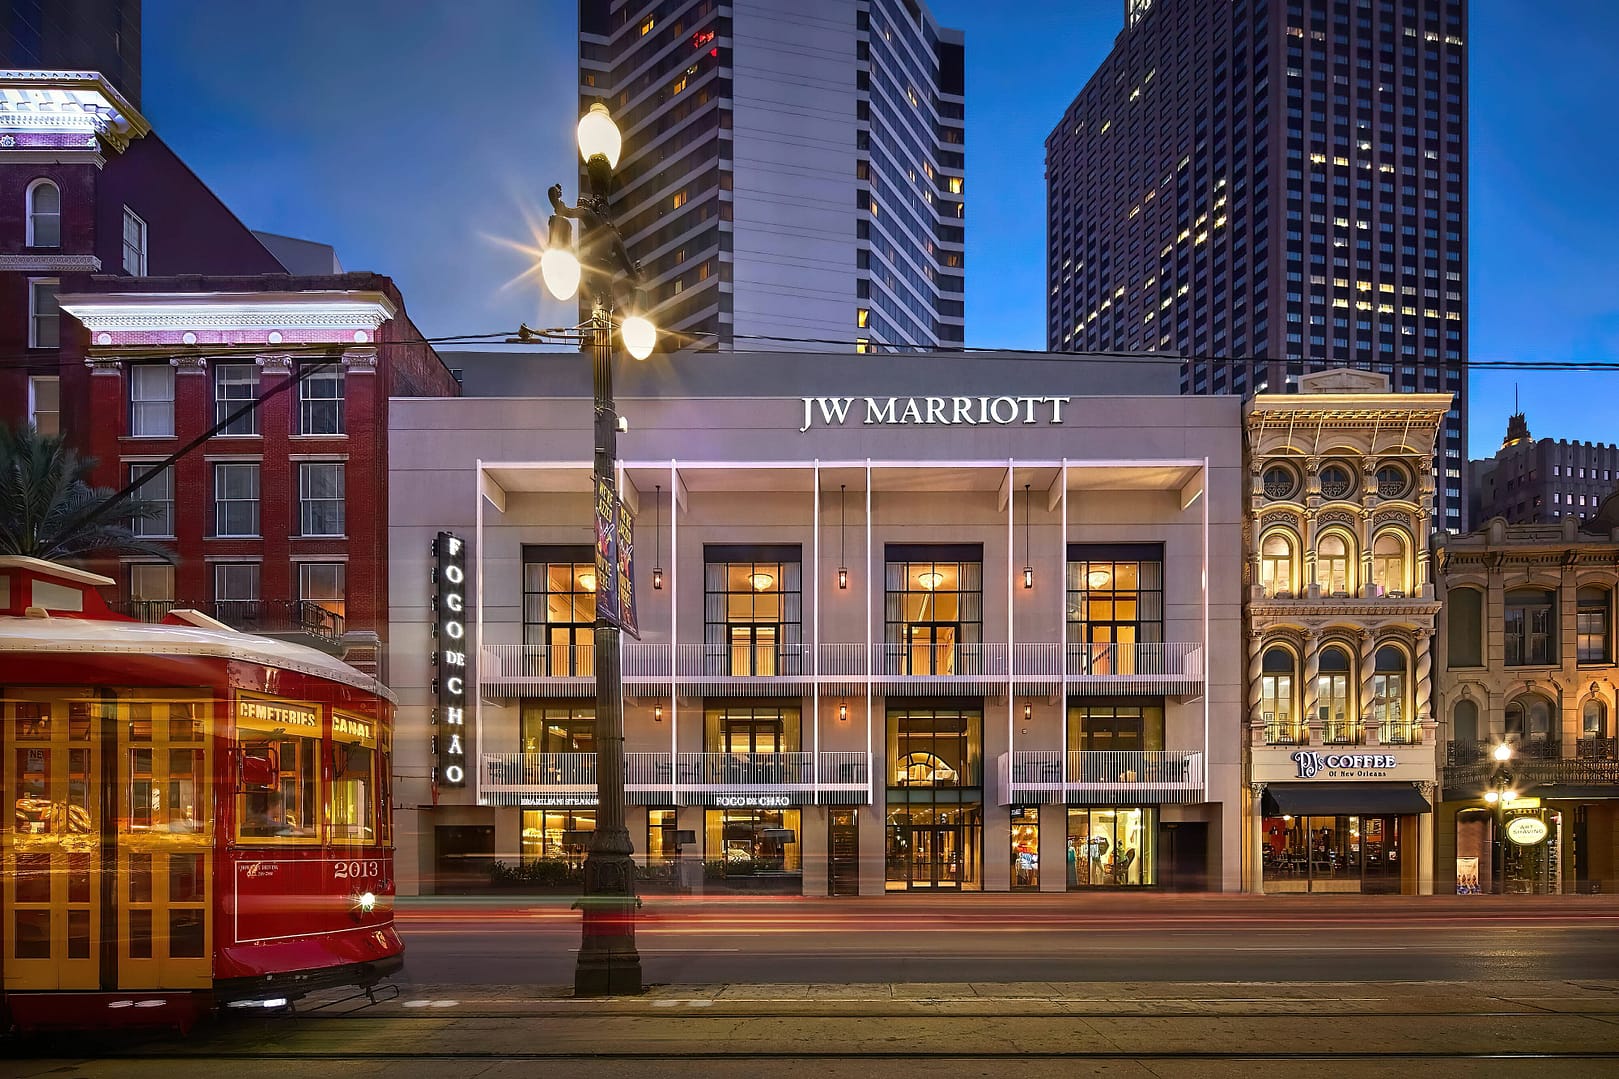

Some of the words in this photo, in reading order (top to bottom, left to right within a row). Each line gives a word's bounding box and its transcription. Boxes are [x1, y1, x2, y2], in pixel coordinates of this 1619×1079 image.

[800, 397, 855, 432] JW
[863, 396, 1070, 425] MARRIOTT
[446, 538, 463, 638] FOGO
[446, 650, 465, 666] DE
[240, 702, 316, 727] CEMETERIES
[332, 716, 371, 739] CANAL
[1326, 755, 1397, 769] COFFEE
[565, 798, 599, 806] STEAKH
[716, 796, 745, 806] FOGO
[334, 861, 378, 878] 2013
